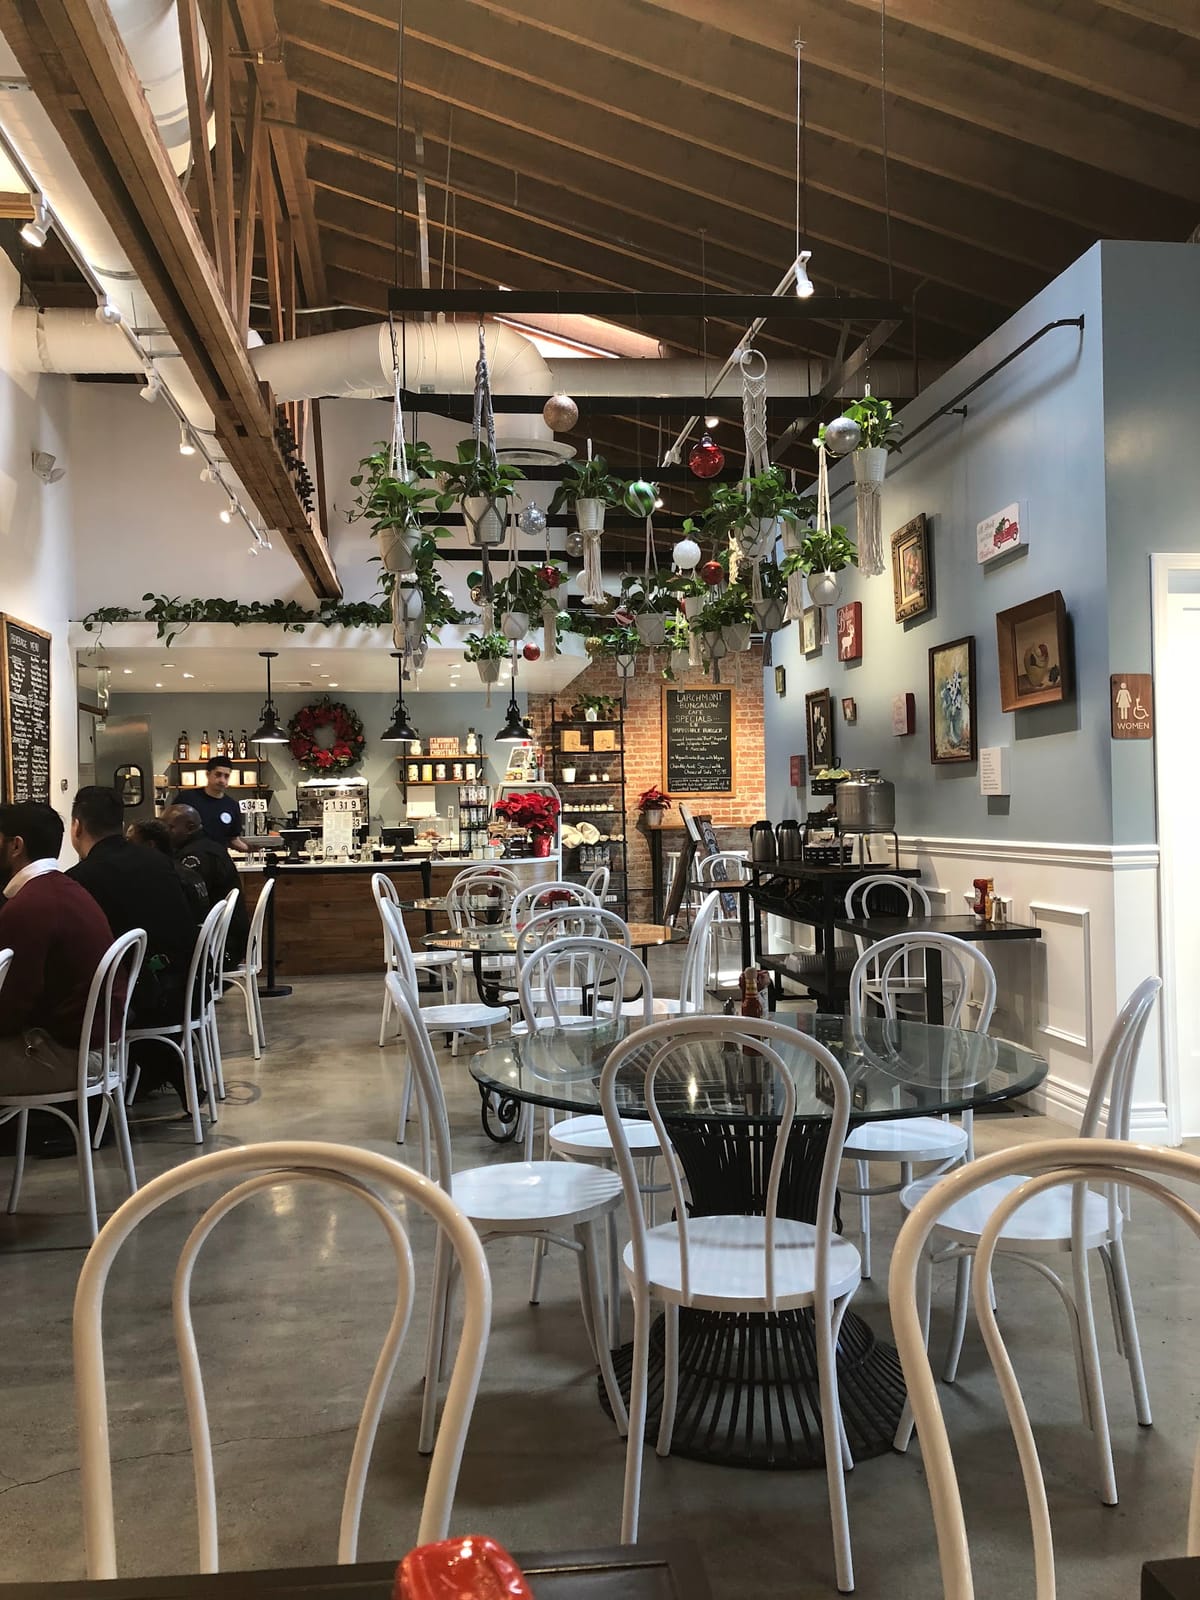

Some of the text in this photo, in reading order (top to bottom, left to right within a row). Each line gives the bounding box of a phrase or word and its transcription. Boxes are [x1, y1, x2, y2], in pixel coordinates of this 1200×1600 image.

[676, 692, 723, 703] LARCHMONT
[675, 715, 713, 723] SPECIALS
[1117, 722, 1150, 730] WOMEN
